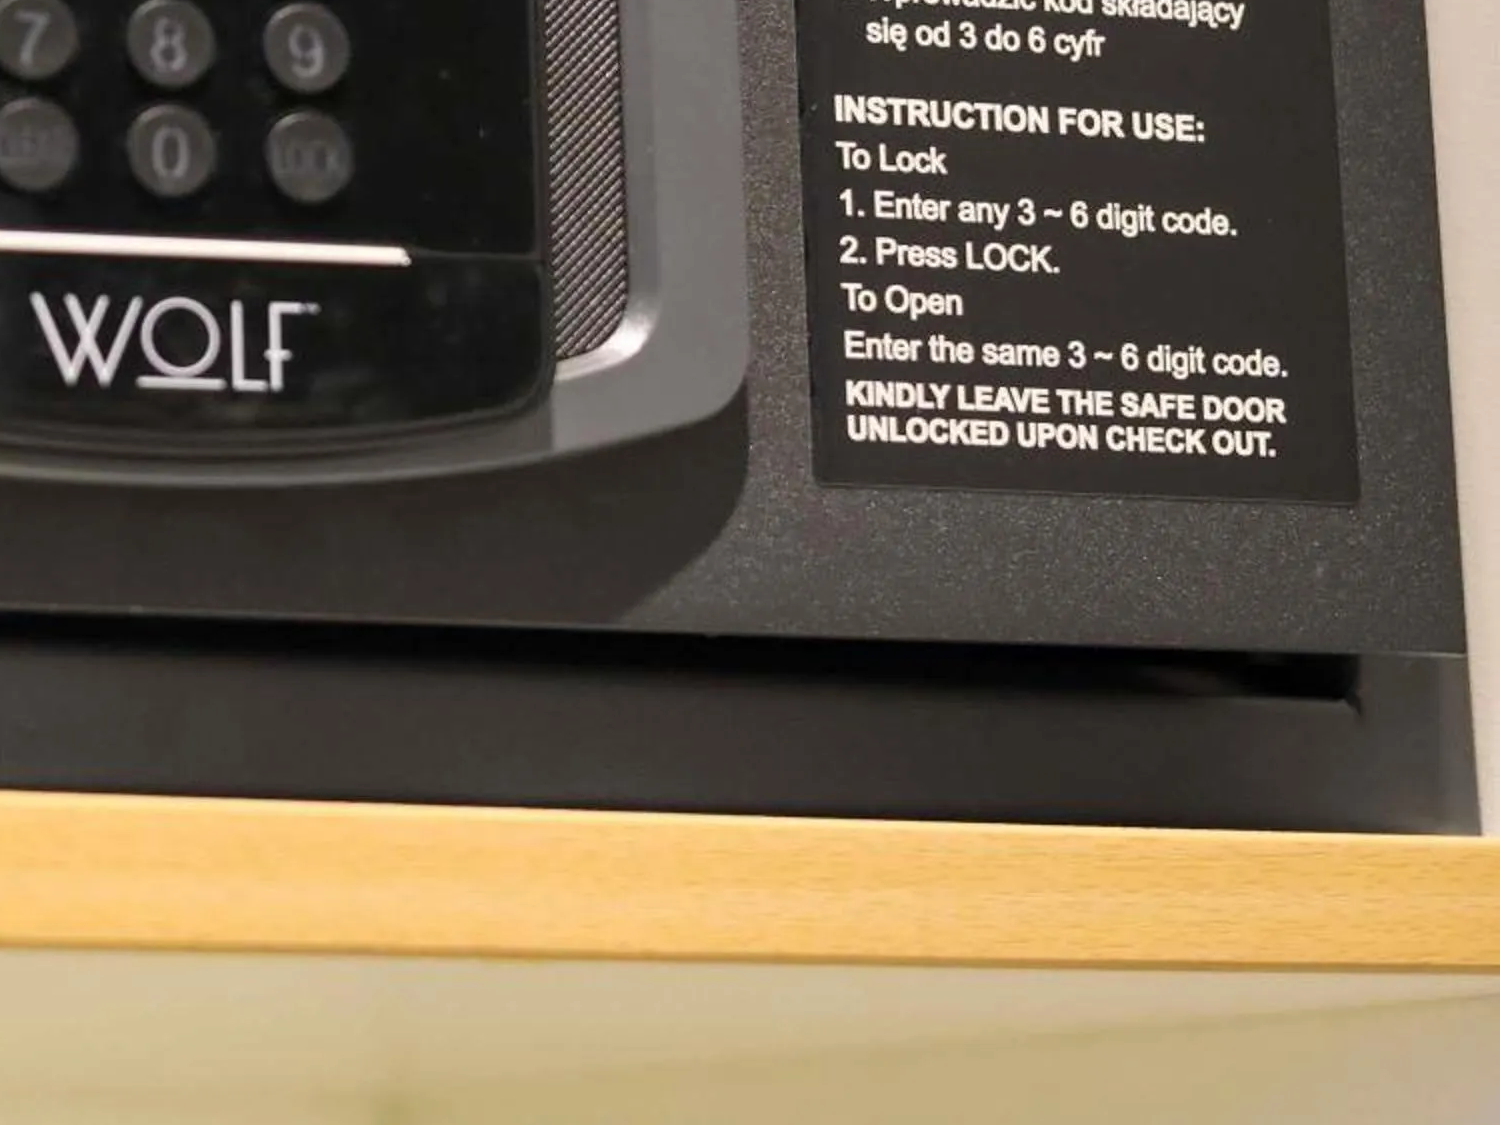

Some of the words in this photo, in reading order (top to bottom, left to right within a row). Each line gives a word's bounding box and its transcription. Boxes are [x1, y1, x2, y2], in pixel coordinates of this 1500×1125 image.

[15, 11, 50, 67] 7
[149, 17, 188, 72] 8
[288, 24, 324, 76] 9
[866, 18, 906, 51] się
[915, 22, 951, 47] od
[958, 22, 977, 48] 3
[985, 23, 1021, 50] do
[1027, 25, 1046, 52] 6
[1054, 28, 1106, 61] cyfr
[833, 95, 1050, 133] INSTRUCTION
[1057, 107, 1124, 139] FOR
[1131, 112, 1205, 143] USE:
[152, 126, 190, 179] 0
[836, 141, 871, 170] To
[879, 144, 948, 175] Lock
[839, 189, 865, 219] 1.
[873, 191, 950, 222] Enter
[958, 200, 1009, 230] any
[1017, 199, 1036, 226] 3
[1069, 200, 1088, 228] 6
[1096, 204, 1156, 238] digit
[1162, 208, 1238, 235] code.
[839, 236, 867, 265] 2.
[875, 238, 958, 268] Press
[965, 242, 1060, 274] LOCK.
[841, 282, 876, 311] To
[884, 285, 963, 320] Open
[29, 291, 321, 392] WOLF
[844, 331, 921, 362] Enter
[928, 335, 975, 364] the
[981, 343, 1060, 367] same
[1067, 341, 1086, 368] 3
[1120, 342, 1139, 370] 6
[1147, 344, 1206, 379] digit
[1213, 348, 1288, 377] code.
[845, 380, 951, 410] KINDLY
[958, 386, 1051, 414] LEAVE
[1056, 389, 1114, 416] THE
[1120, 391, 1197, 419] SAFE
[1202, 395, 1286, 424] DOOR
[846, 415, 1010, 447] UNLOCKED
[1017, 423, 1099, 450] UPON
[1105, 425, 1206, 455] CHECK
[1212, 430, 1276, 457] OUT.
